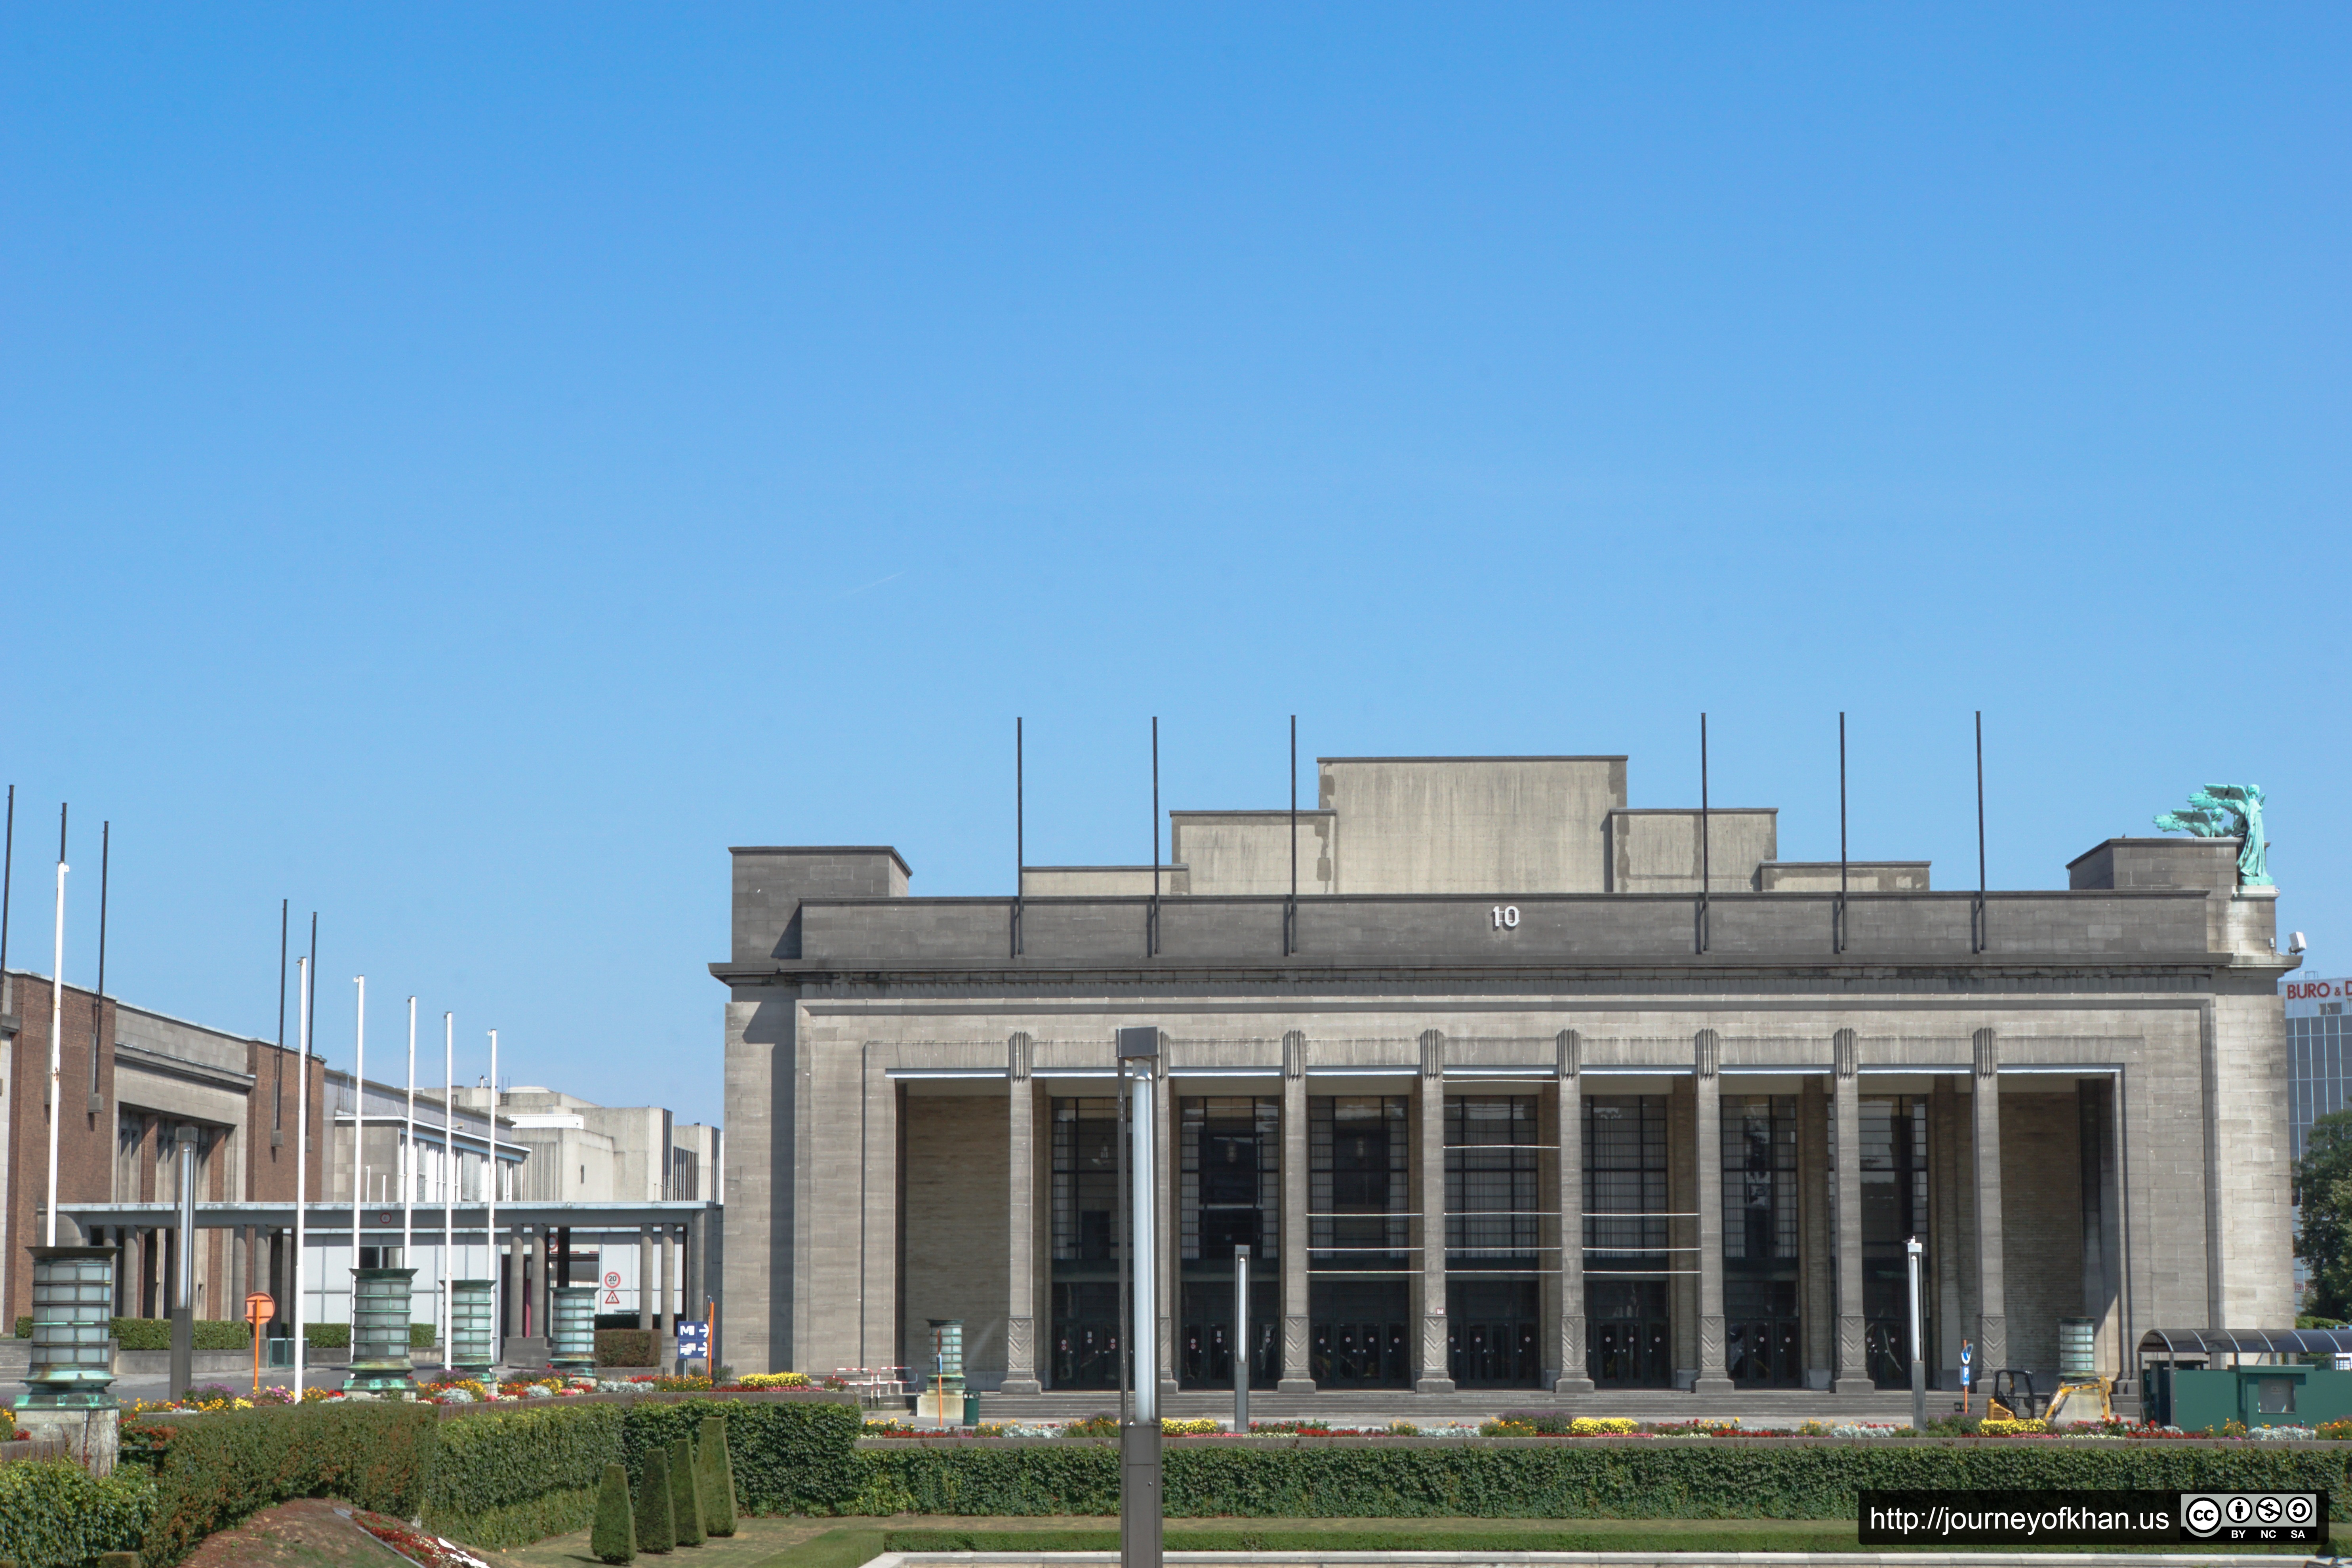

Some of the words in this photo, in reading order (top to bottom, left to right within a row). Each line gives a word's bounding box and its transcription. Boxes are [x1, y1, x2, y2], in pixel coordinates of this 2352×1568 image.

[1493, 906, 1519, 927] 10
[2287, 982, 2330, 999] BURO
[2334, 987, 2341, 996] &
[1964, 1367, 1969, 1378] P
